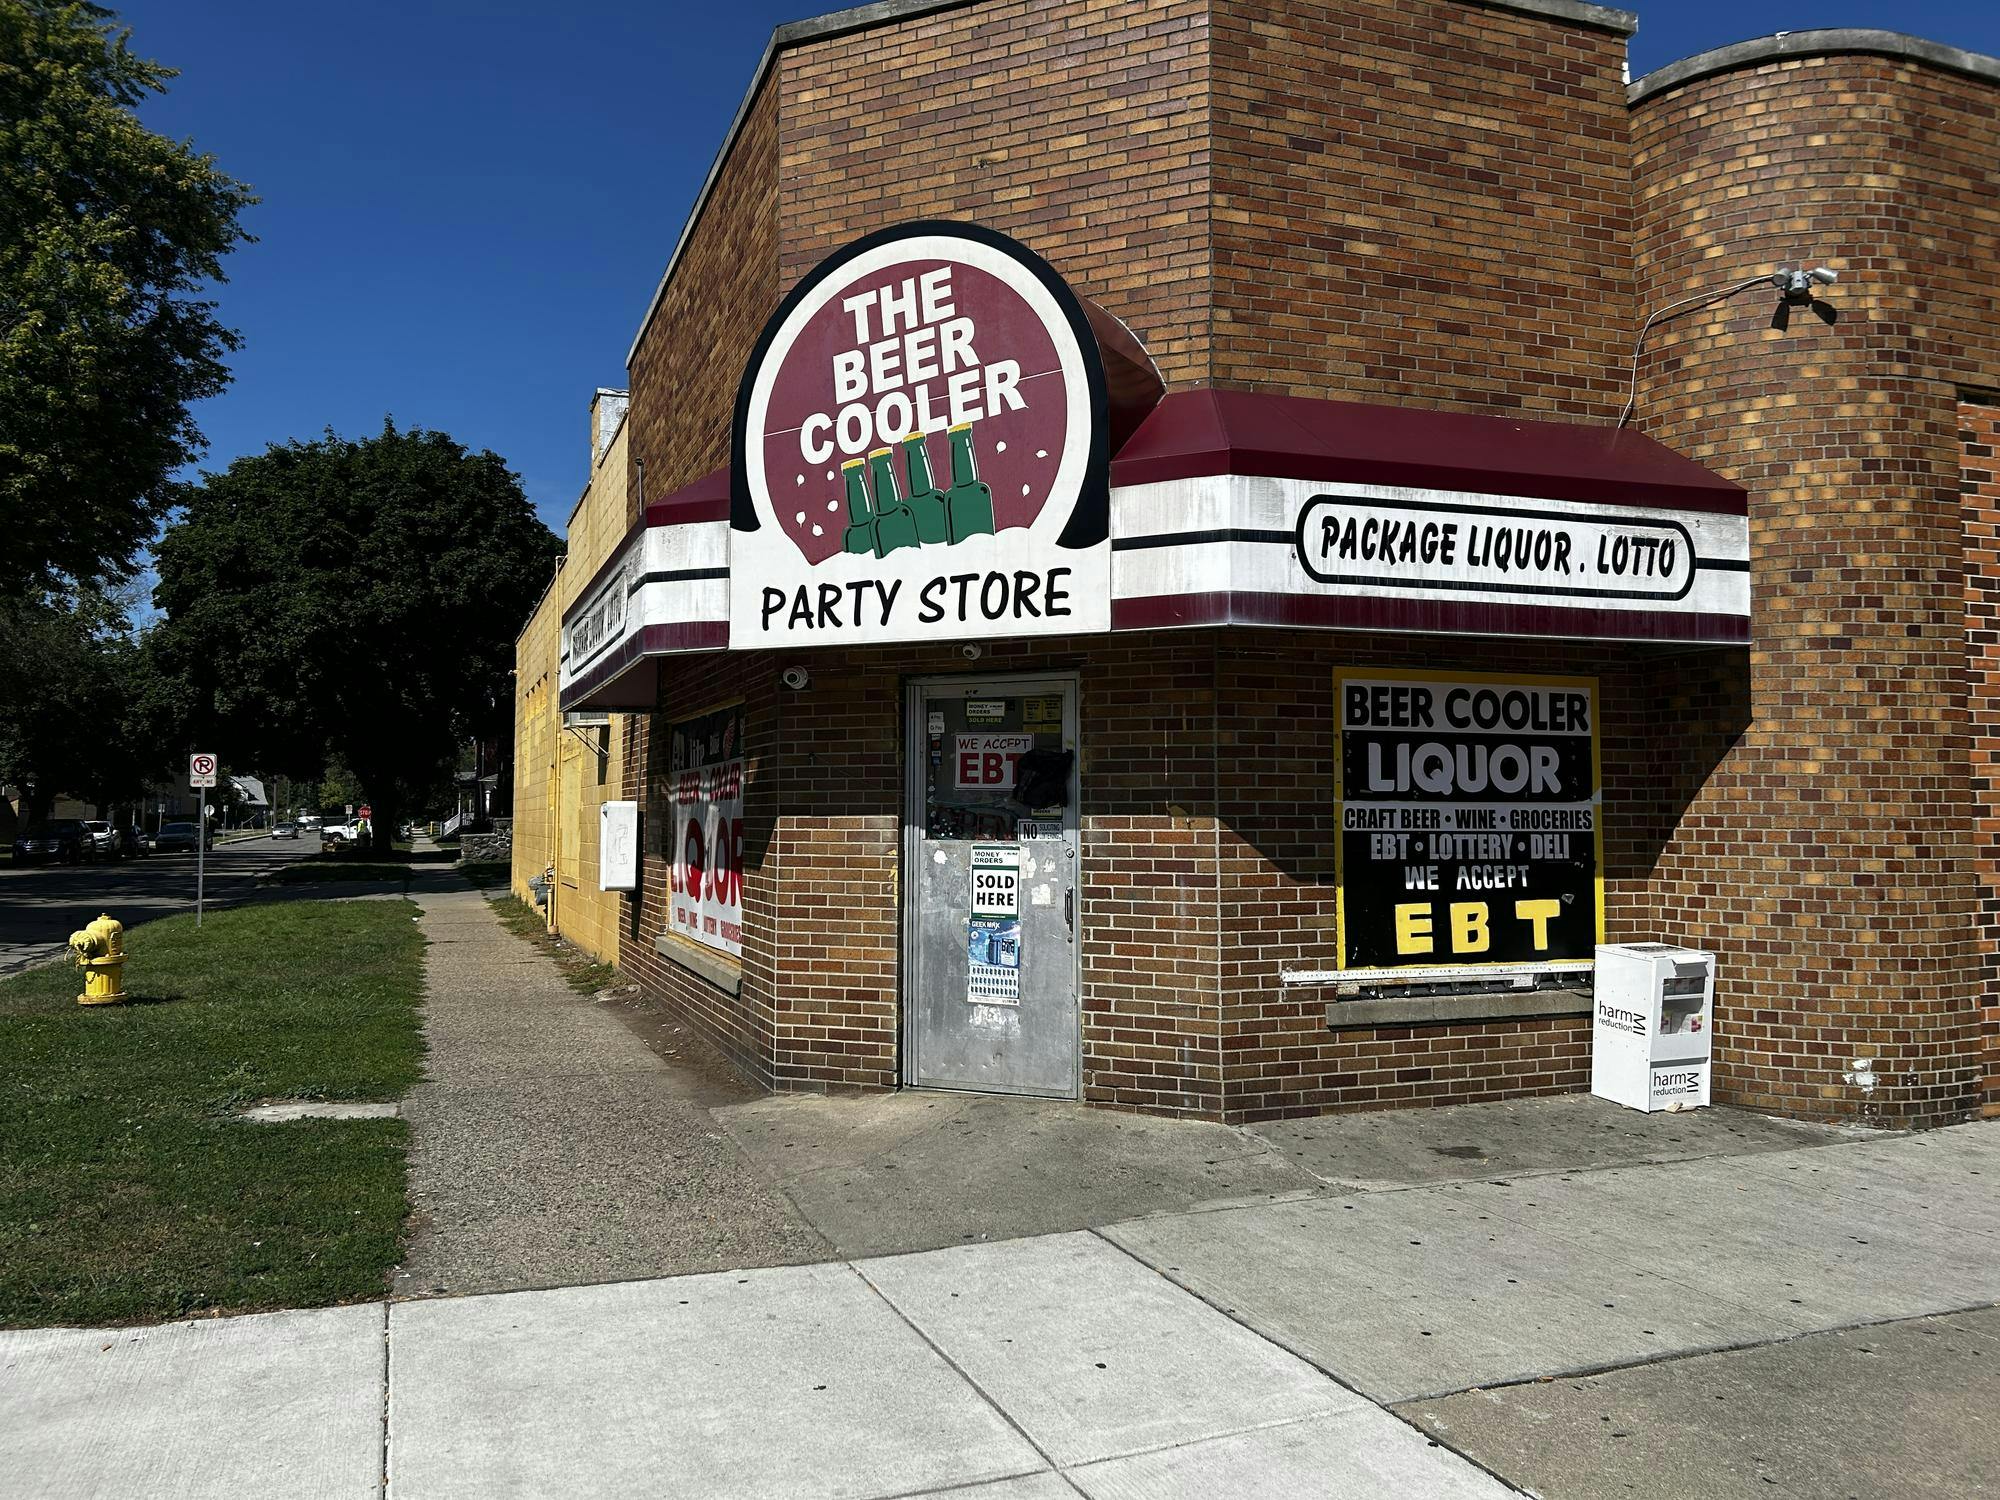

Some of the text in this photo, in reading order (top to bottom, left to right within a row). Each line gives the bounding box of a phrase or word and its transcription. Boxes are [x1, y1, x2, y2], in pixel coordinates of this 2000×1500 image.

[842, 264, 956, 346] THE
[833, 317, 981, 405] BEER
[800, 359, 1029, 465] COOLER
[1320, 515, 1675, 578] PACKAGE LIQUOR LOTTO
[762, 567, 1072, 631] PARTY STORE
[1345, 685, 1589, 732] BEER COOLER
[958, 738, 1031, 750] WE ACCEPT
[960, 752, 1024, 785] EBT
[1367, 742, 1562, 795] LIQUOR
[710, 762, 741, 802] COOLER
[1023, 823, 1038, 839] NO
[1344, 808, 1592, 830] CRAFT BEER WINE GROCERIES
[1370, 834, 1570, 860] EBT LOTTERY DELI
[976, 875, 1014, 889] SOLD
[1405, 864, 1530, 890] WE ACCEPT
[976, 892, 1014, 906] HERE
[1599, 1000, 1633, 1023] harm
[1598, 1017, 1633, 1033] reduction
[1653, 1086, 1687, 1096] reduction
[1654, 1071, 1687, 1086] harm
